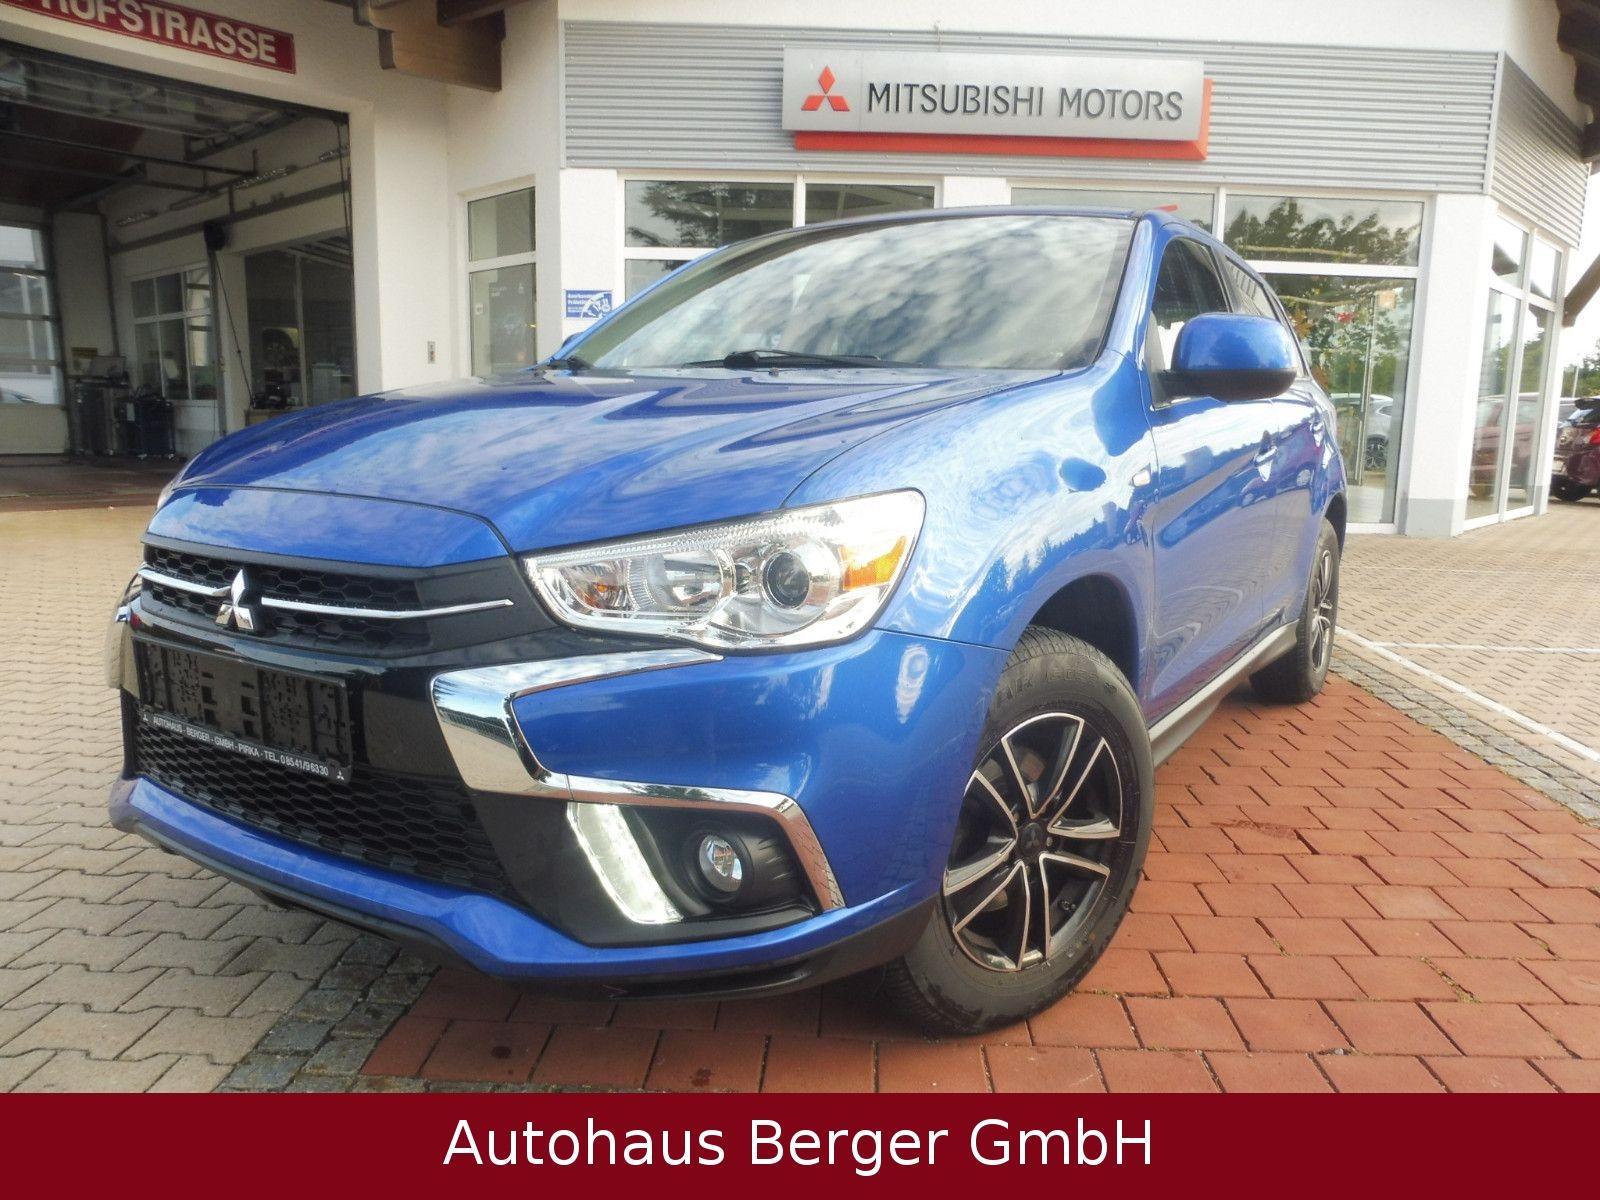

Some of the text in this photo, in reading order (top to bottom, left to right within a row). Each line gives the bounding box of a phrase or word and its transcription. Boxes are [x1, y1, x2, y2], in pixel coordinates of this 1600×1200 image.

[867, 82, 1183, 122] MITSUBISHI MOTORS
[153, 716, 183, 734] AUTOHAUS
[186, 726, 210, 743] BERGER
